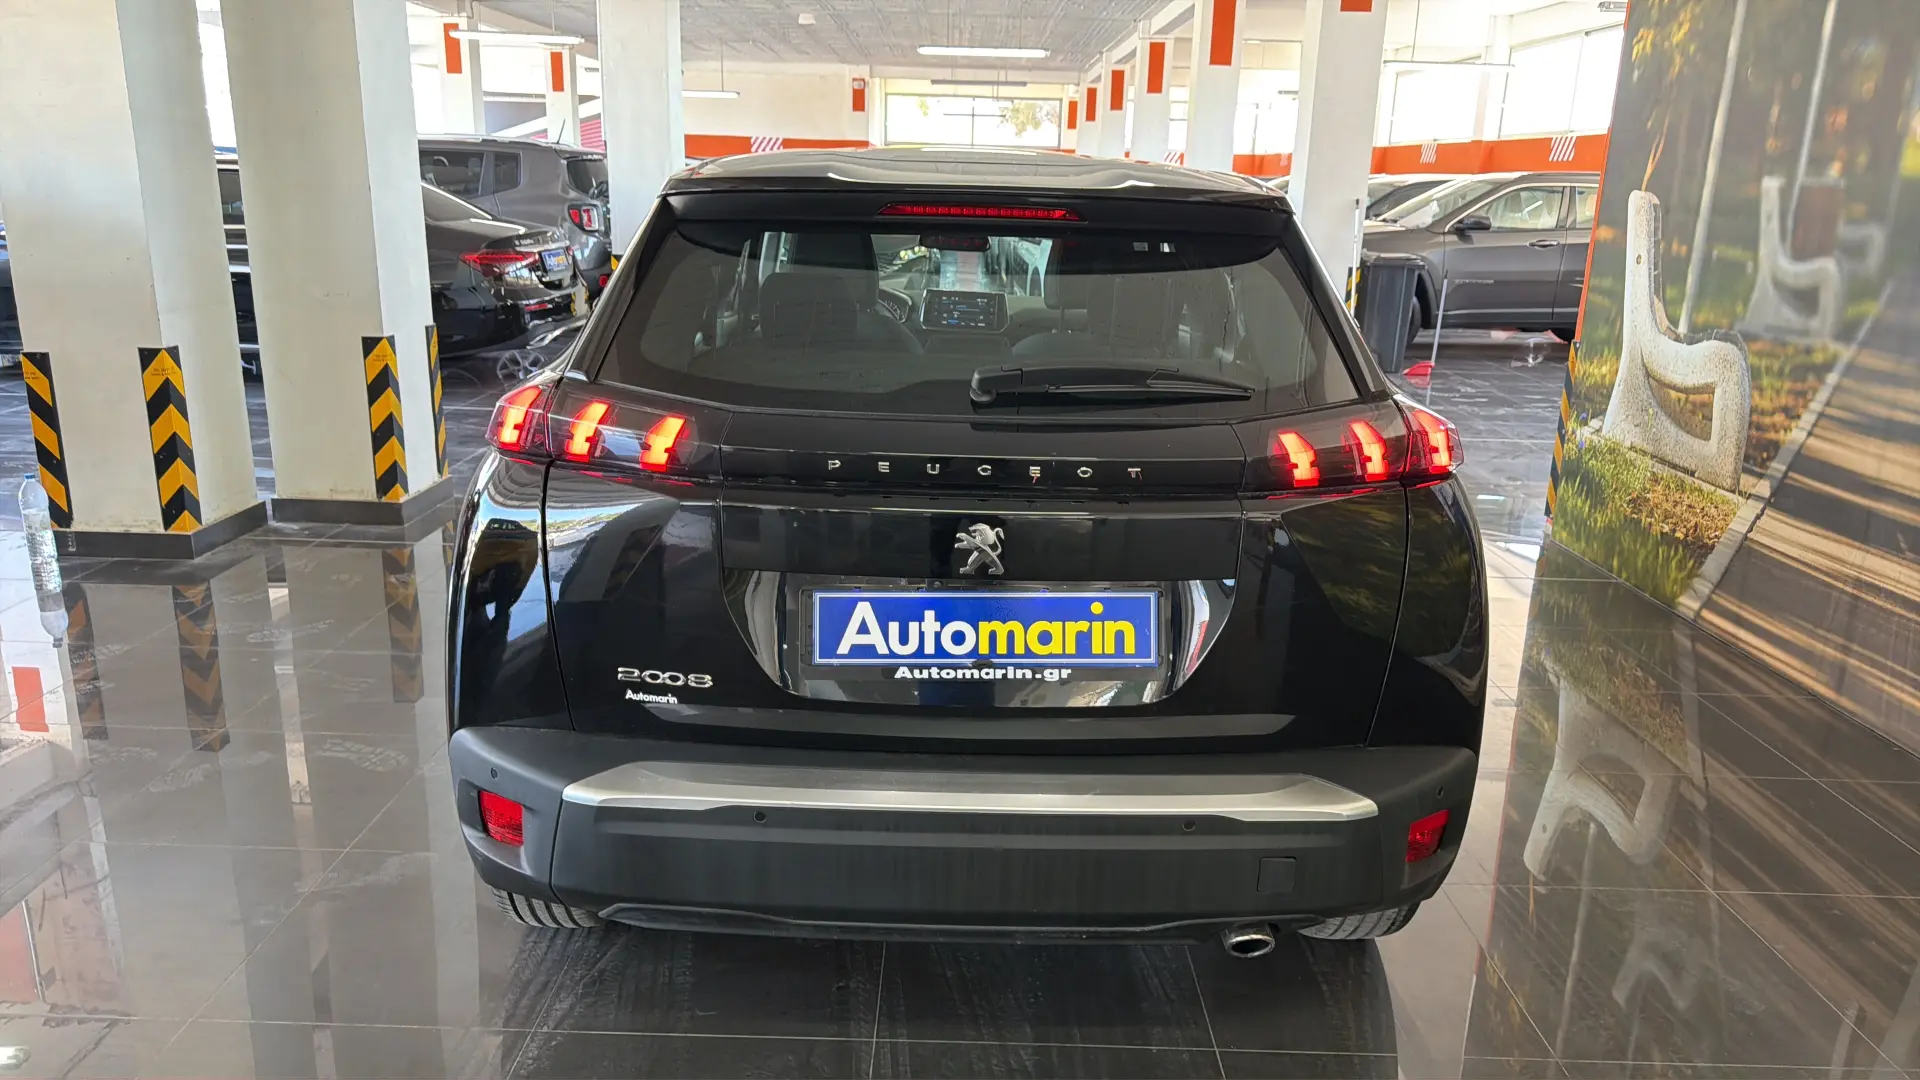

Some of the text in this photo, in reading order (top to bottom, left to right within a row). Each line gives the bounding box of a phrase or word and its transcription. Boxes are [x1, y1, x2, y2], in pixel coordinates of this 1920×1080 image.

[828, 459, 1142, 480] PEUGEOT
[836, 601, 1136, 655] Automarin
[617, 667, 713, 688] 2008
[894, 667, 1071, 682] Automarin.gr
[625, 689, 678, 704] Automarin
